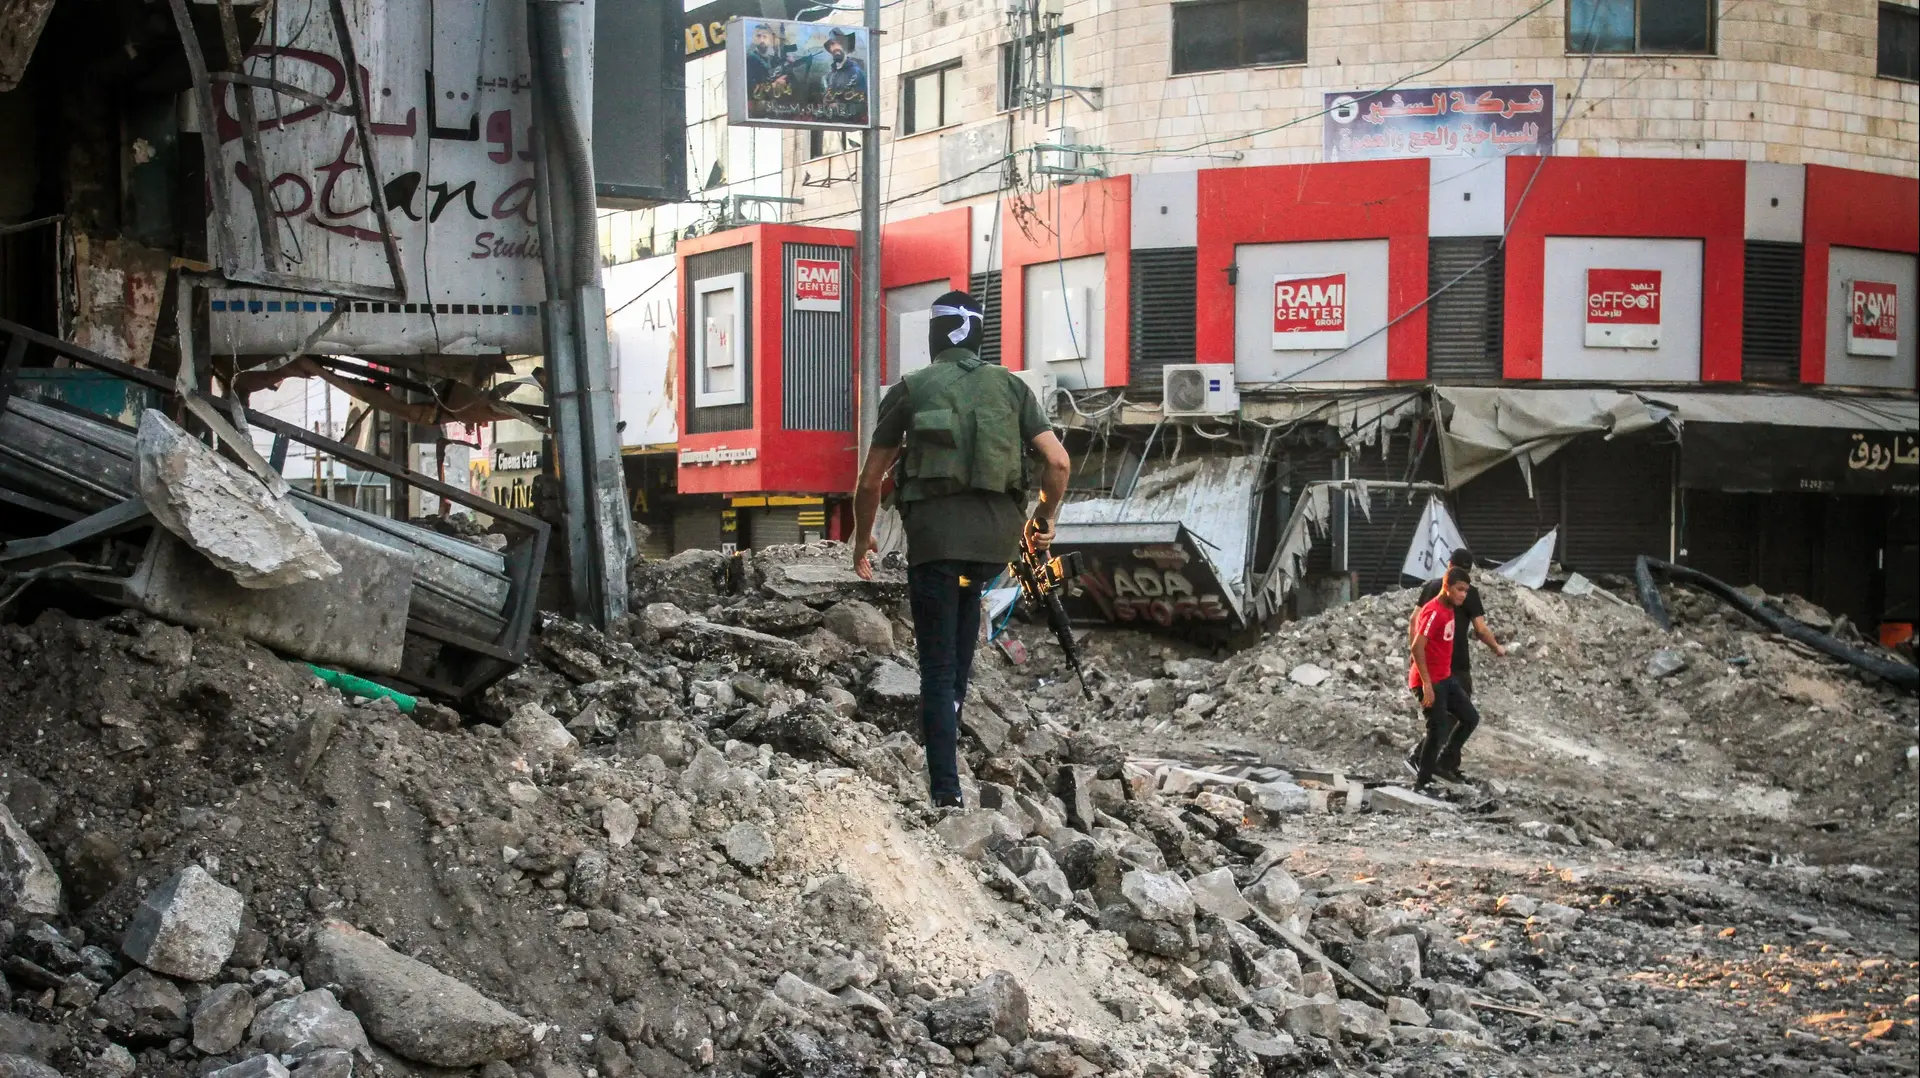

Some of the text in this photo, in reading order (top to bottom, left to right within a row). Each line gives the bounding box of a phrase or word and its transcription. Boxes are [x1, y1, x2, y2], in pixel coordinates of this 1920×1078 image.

[1362, 88, 1544, 125] شركة السفير
[1340, 122, 1539, 154] للسياحة والحج والعمرة
[798, 266, 839, 283] RAMI
[798, 282, 839, 292] CENTER
[1277, 284, 1343, 307] RAMI
[1276, 308, 1343, 320] CENTER
[1854, 291, 1895, 316] RAMI
[498, 450, 537, 470] Cinema Cafe
